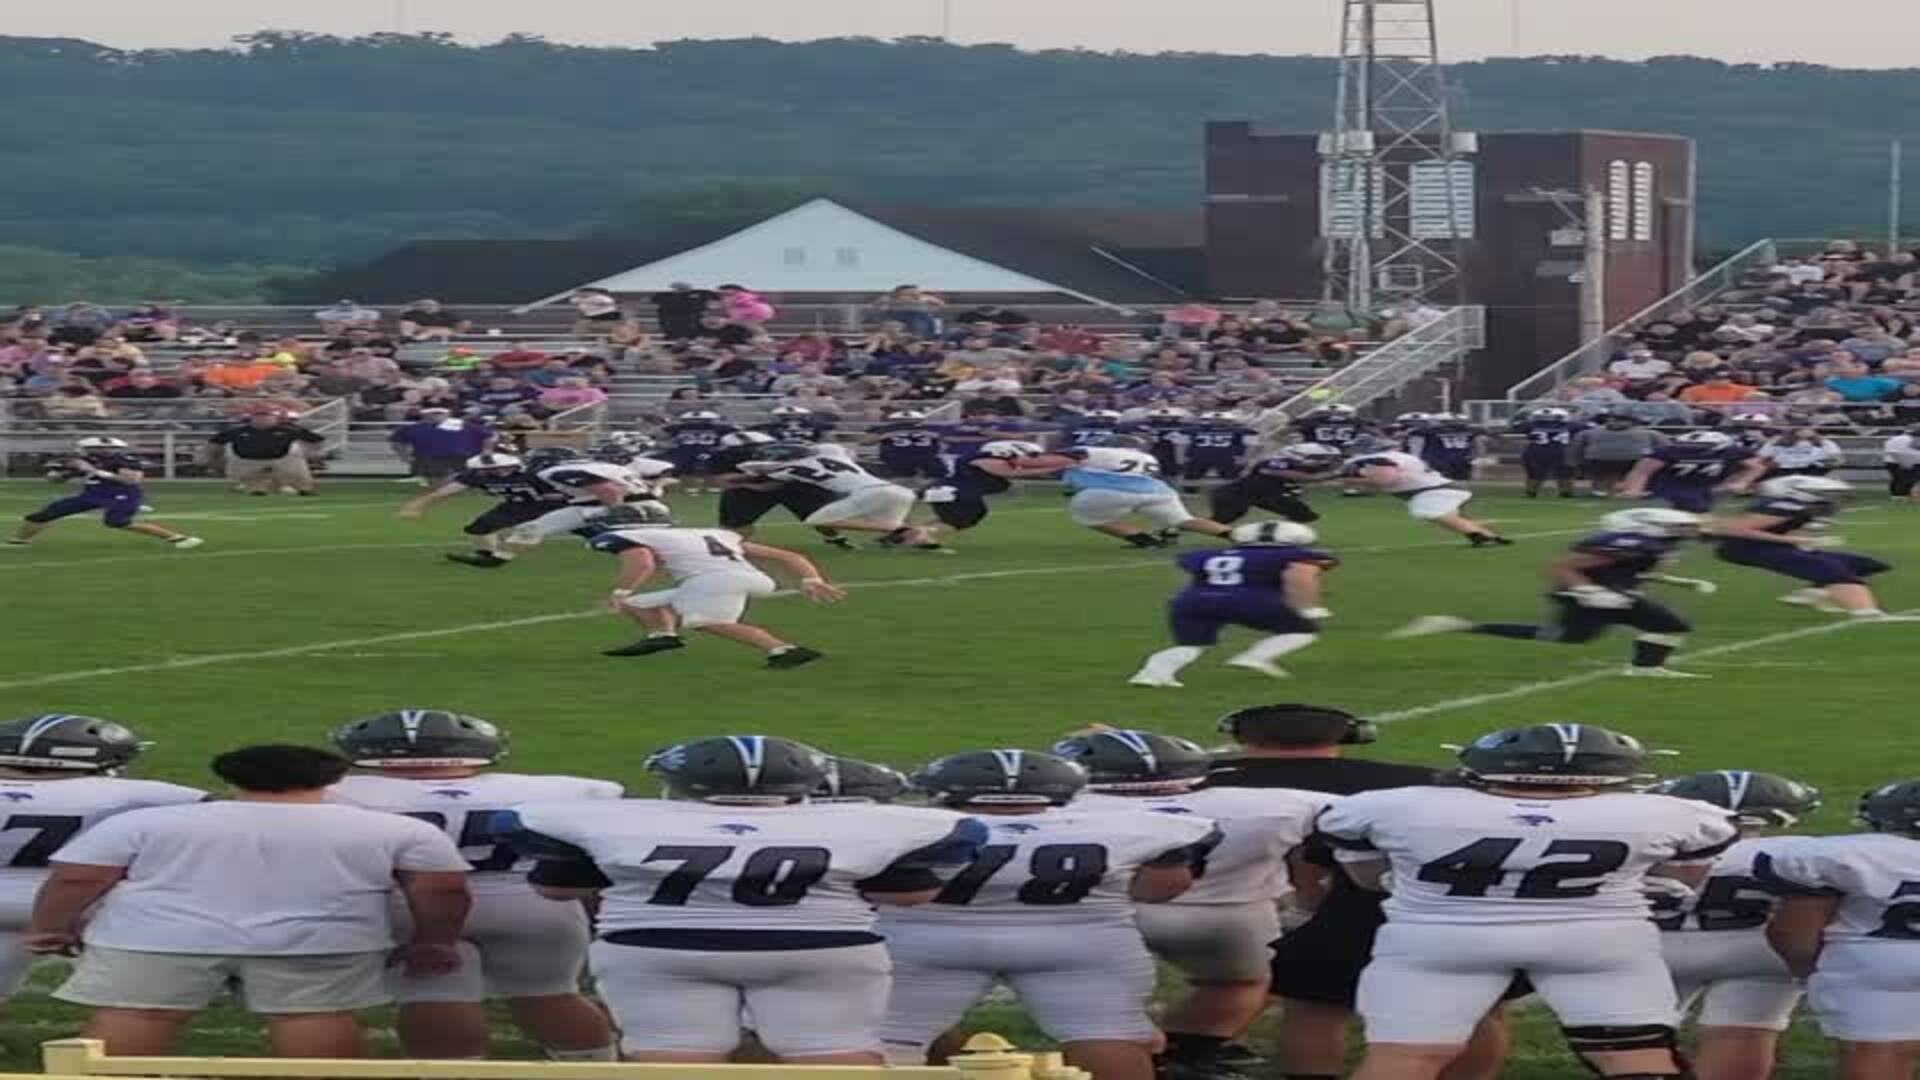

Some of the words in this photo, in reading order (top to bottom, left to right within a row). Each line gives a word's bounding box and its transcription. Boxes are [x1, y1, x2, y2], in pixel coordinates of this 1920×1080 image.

[893, 433, 931, 447] 53
[1195, 435, 1232, 447] 35
[1530, 431, 1569, 445] 34
[1672, 462, 1722, 477] 74
[703, 535, 738, 561] 4
[1203, 555, 1245, 585] 8
[640, 845, 832, 906] 70
[1417, 837, 1630, 898] 42
